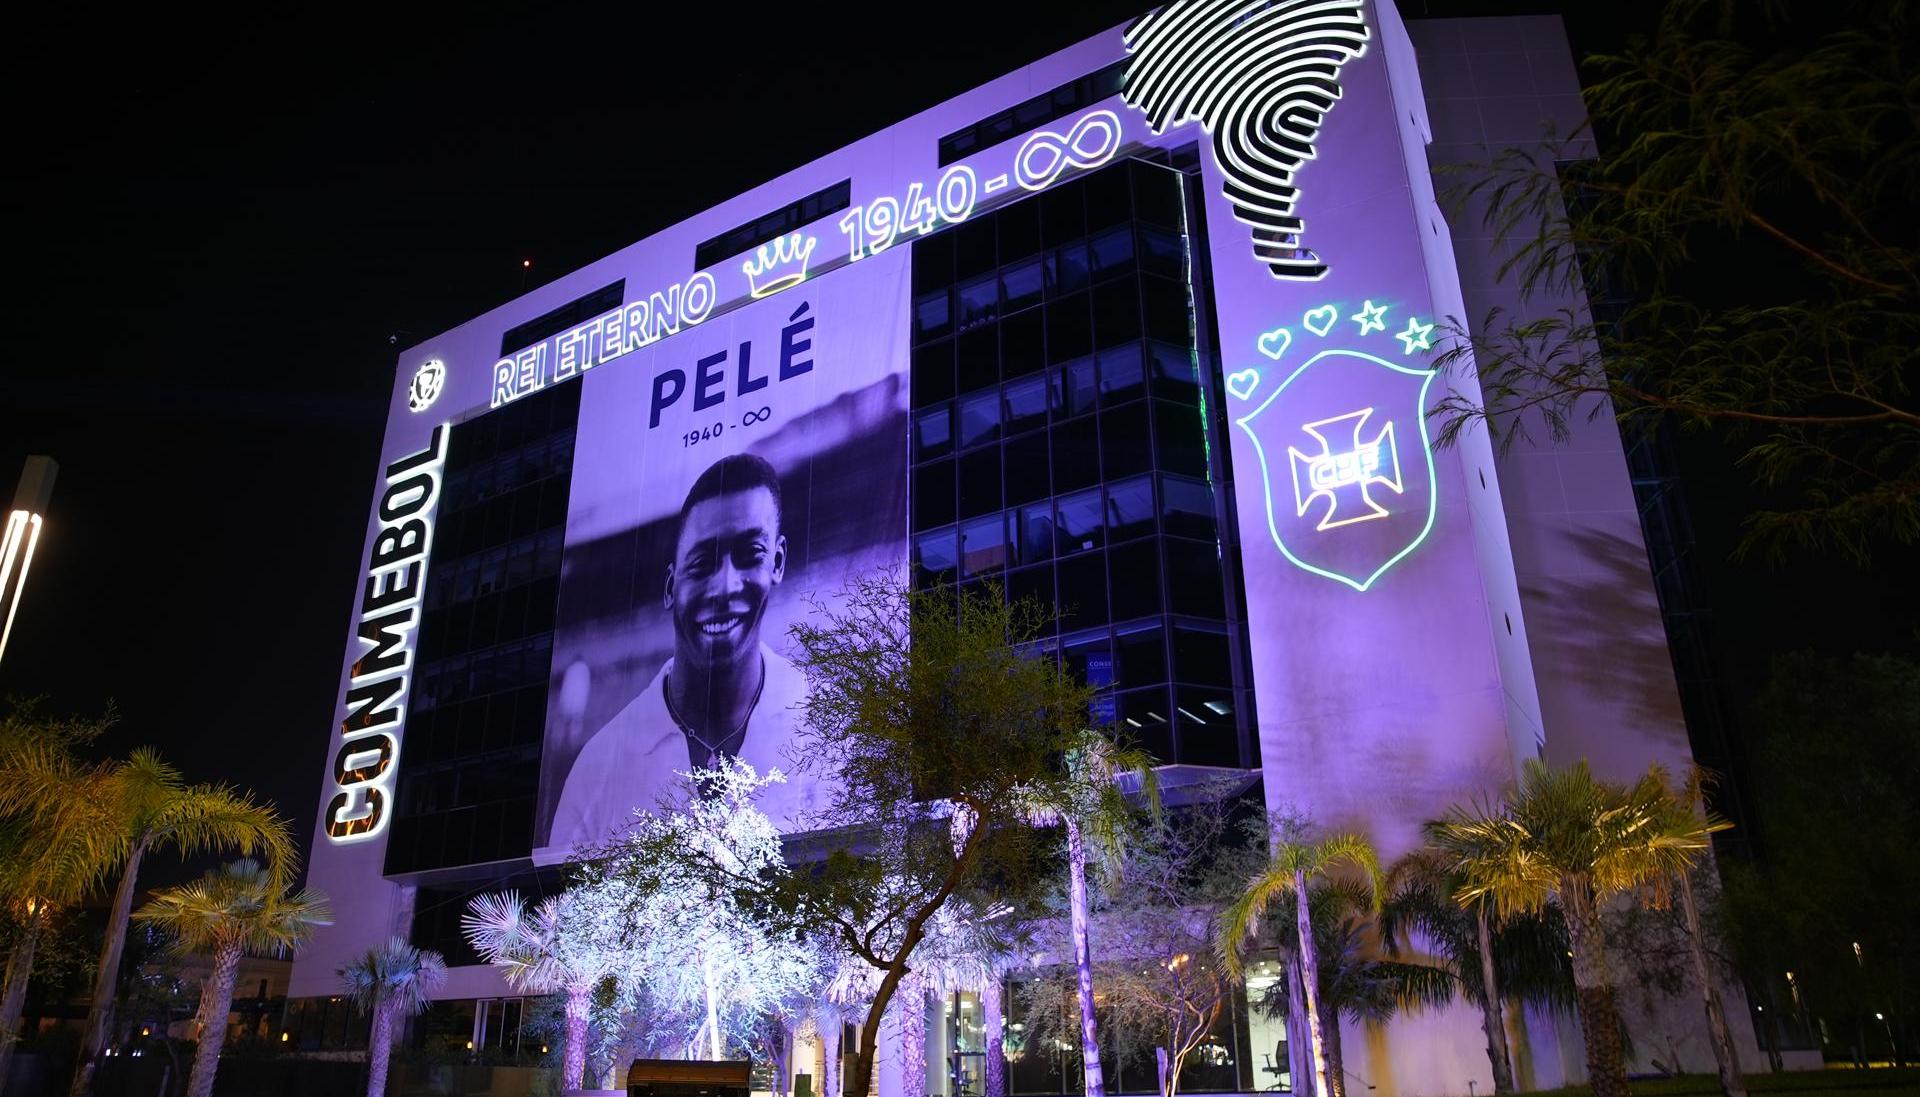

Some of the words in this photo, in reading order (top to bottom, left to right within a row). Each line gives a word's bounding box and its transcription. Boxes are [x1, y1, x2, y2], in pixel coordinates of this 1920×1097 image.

[490, 342, 547, 410] REI
[553, 271, 717, 384] ETERNO
[839, 165, 977, 262] 1940
[648, 300, 816, 429] PELÉ
[682, 420, 724, 448] 1940
[325, 422, 450, 844] CONMEBOL
